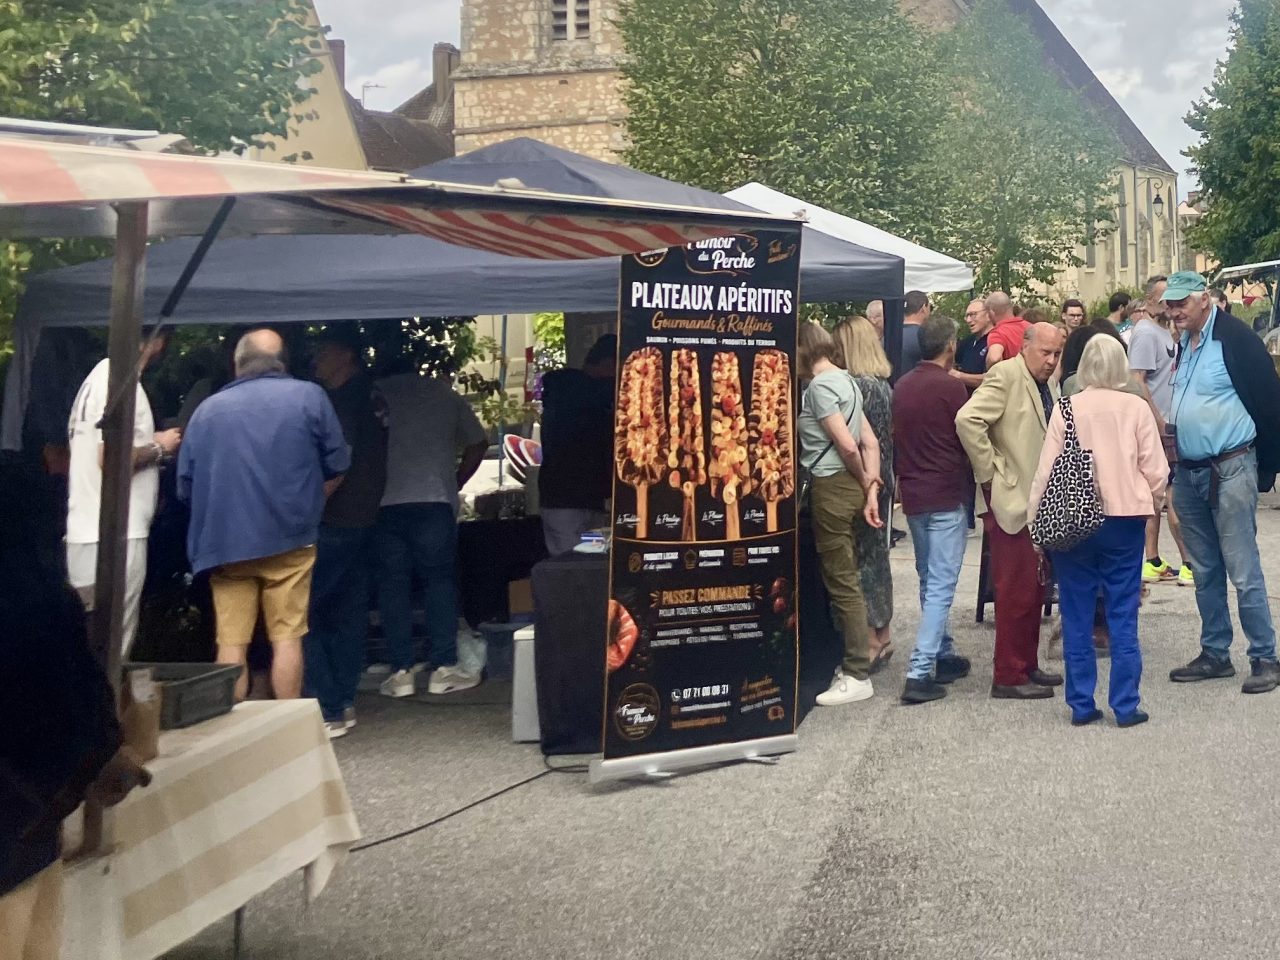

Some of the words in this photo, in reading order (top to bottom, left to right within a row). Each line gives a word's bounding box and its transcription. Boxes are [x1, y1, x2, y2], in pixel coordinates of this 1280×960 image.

[712, 250, 756, 270] Perche
[631, 281, 714, 311] PLATEAUX
[717, 282, 793, 315] APÉRITIFS
[652, 310, 716, 330] Gourmands
[716, 317, 725, 333] &
[727, 313, 774, 336] Raffinés
[662, 588, 696, 606] PASSEZ
[697, 585, 751, 603] COMMANDE
[658, 608, 675, 617] POUR
[676, 606, 700, 616] TOUTES
[700, 604, 713, 615] VOS
[682, 687, 692, 699] 07
[692, 687, 701, 698] 71
[721, 683, 729, 695] 31
